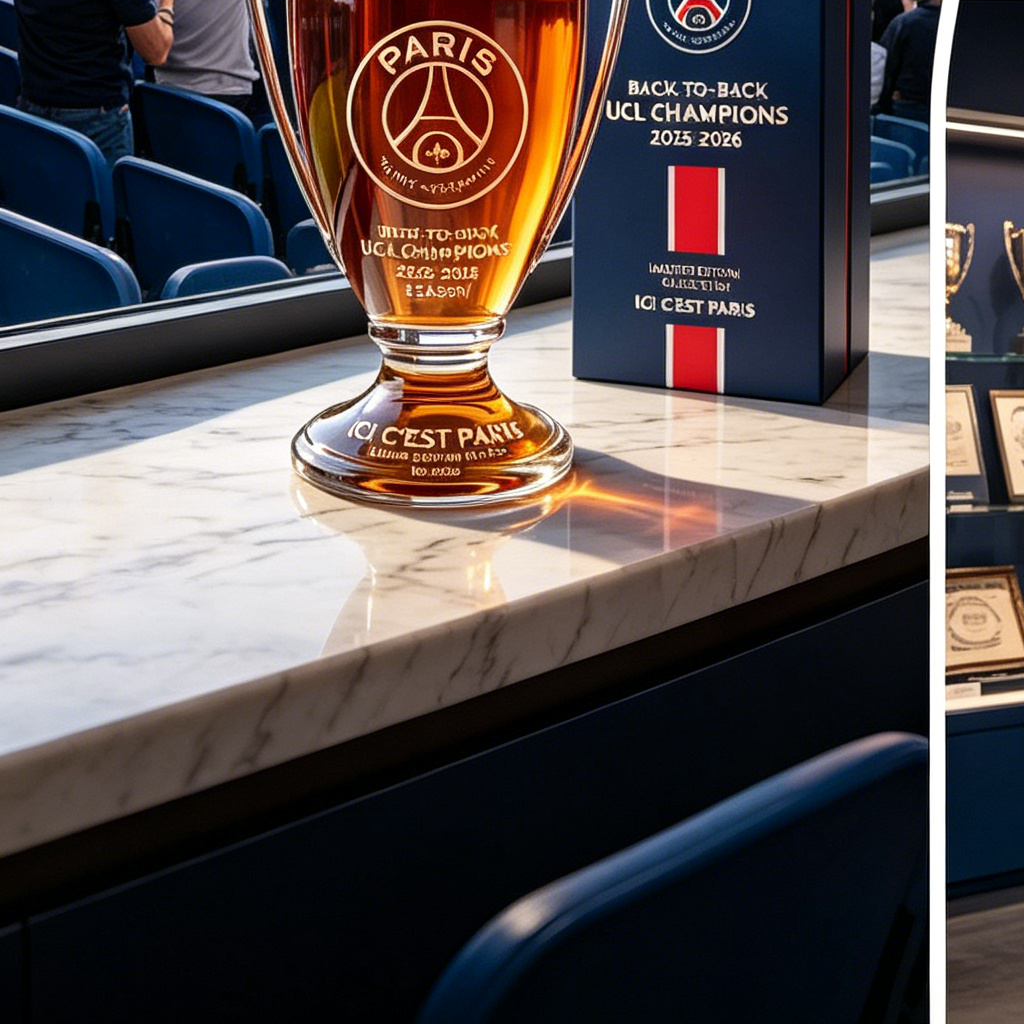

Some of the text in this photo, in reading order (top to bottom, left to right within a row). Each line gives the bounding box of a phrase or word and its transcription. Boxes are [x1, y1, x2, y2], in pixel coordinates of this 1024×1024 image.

[377, 31, 498, 77] PARIS
[628, 79, 679, 98] BACK
[605, 100, 790, 125] UCL CHAMPIONS
